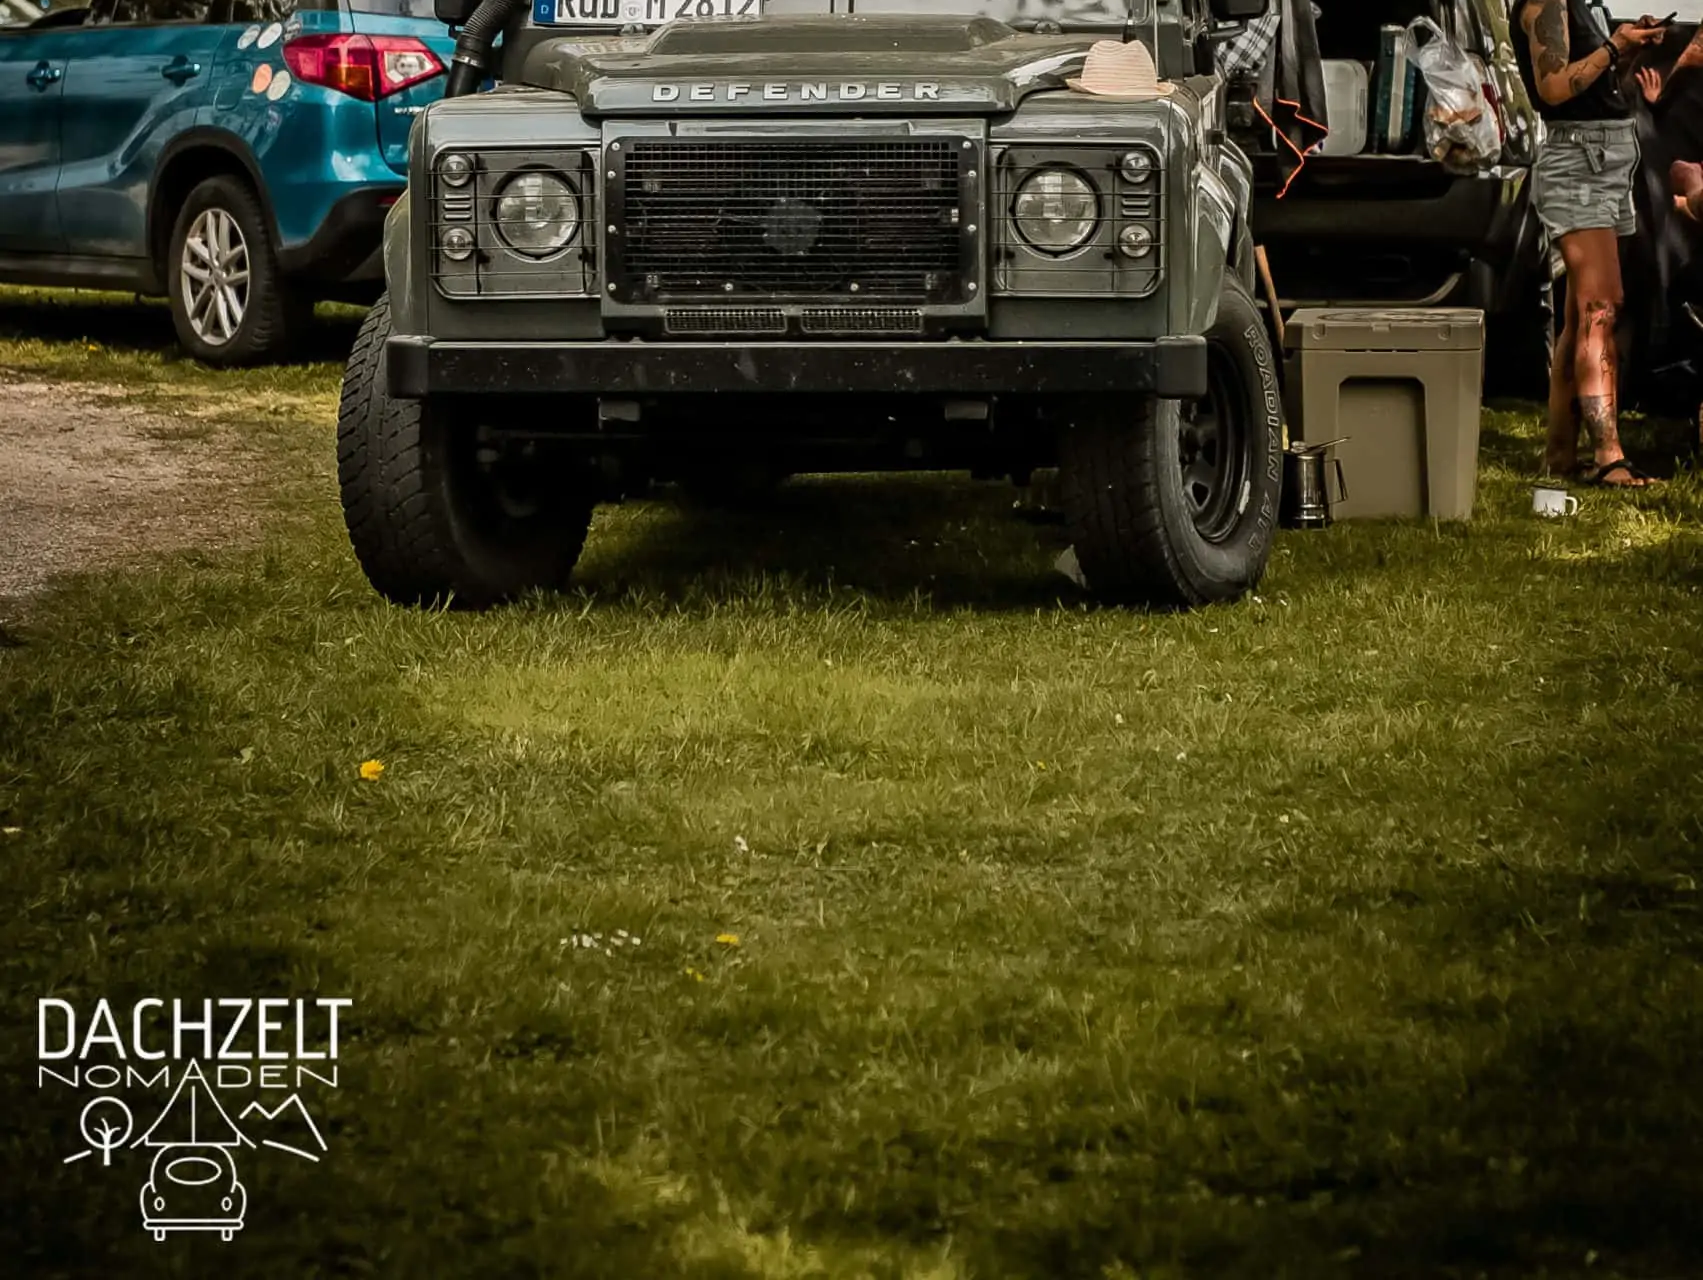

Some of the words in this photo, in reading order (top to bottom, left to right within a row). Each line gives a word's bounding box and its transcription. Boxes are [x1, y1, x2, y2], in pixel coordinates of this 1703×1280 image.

[541, 4, 549, 15] D
[651, 82, 940, 102] DEFENDER
[1244, 324, 1282, 482] ROADIAN
